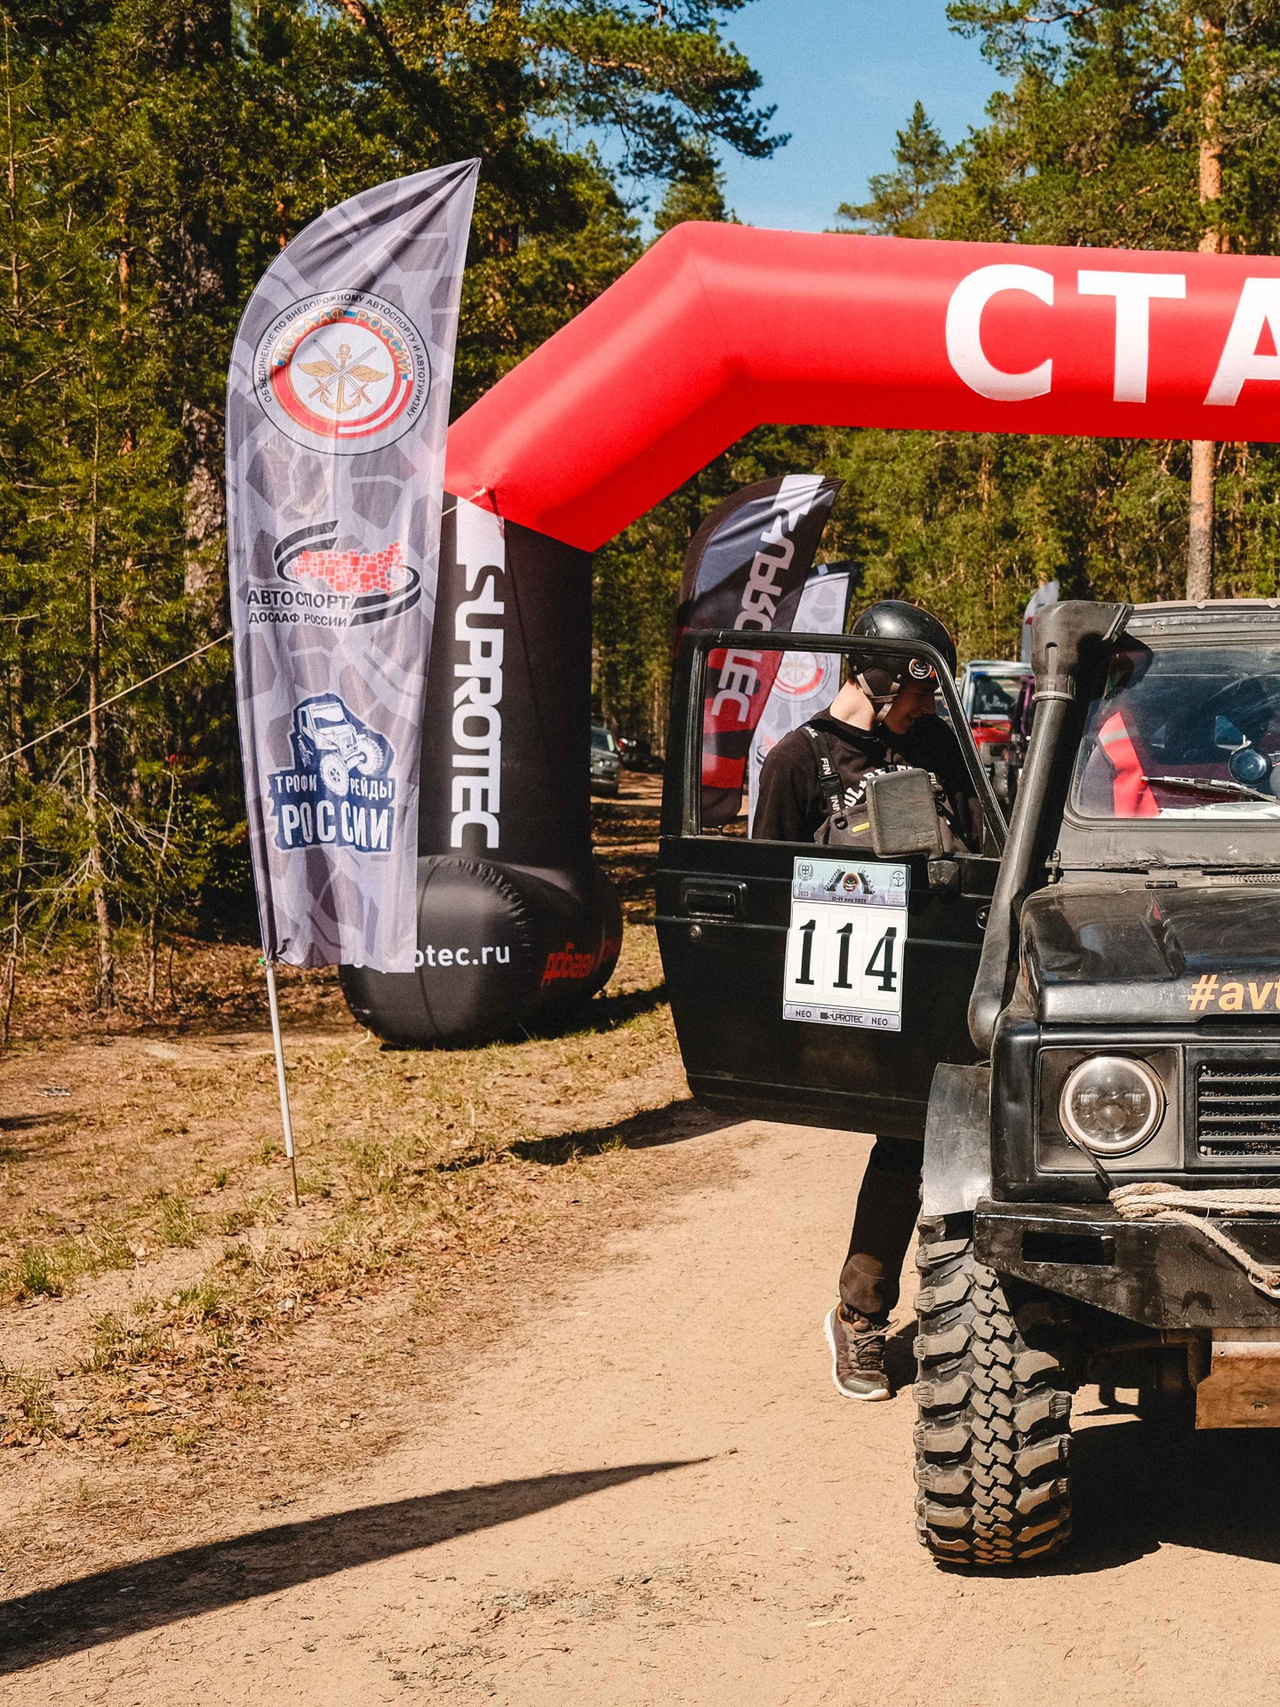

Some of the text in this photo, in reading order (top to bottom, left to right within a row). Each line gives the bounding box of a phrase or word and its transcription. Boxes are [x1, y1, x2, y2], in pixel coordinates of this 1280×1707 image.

[258, 293, 426, 419] ОБЪЕДИНЕНИЕ ПО ВНЕДОРОЖНОМУ АВТОСПОРТУ И АВТОТУРИЗМУ
[275, 307, 412, 375] ДОСААФ РОССИИ
[247, 590, 350, 610] АВТОСПОРТ
[249, 612, 348, 628] ДОСААФ РОССИИ
[450, 496, 506, 849] SUPROTEC
[275, 774, 392, 800] ТРОФИ РЕЙДЫ
[281, 800, 389, 849] РОССИИ
[795, 919, 897, 993] 114
[795, 1010, 812, 1018] NEO
[871, 1017, 888, 1026] NEO
